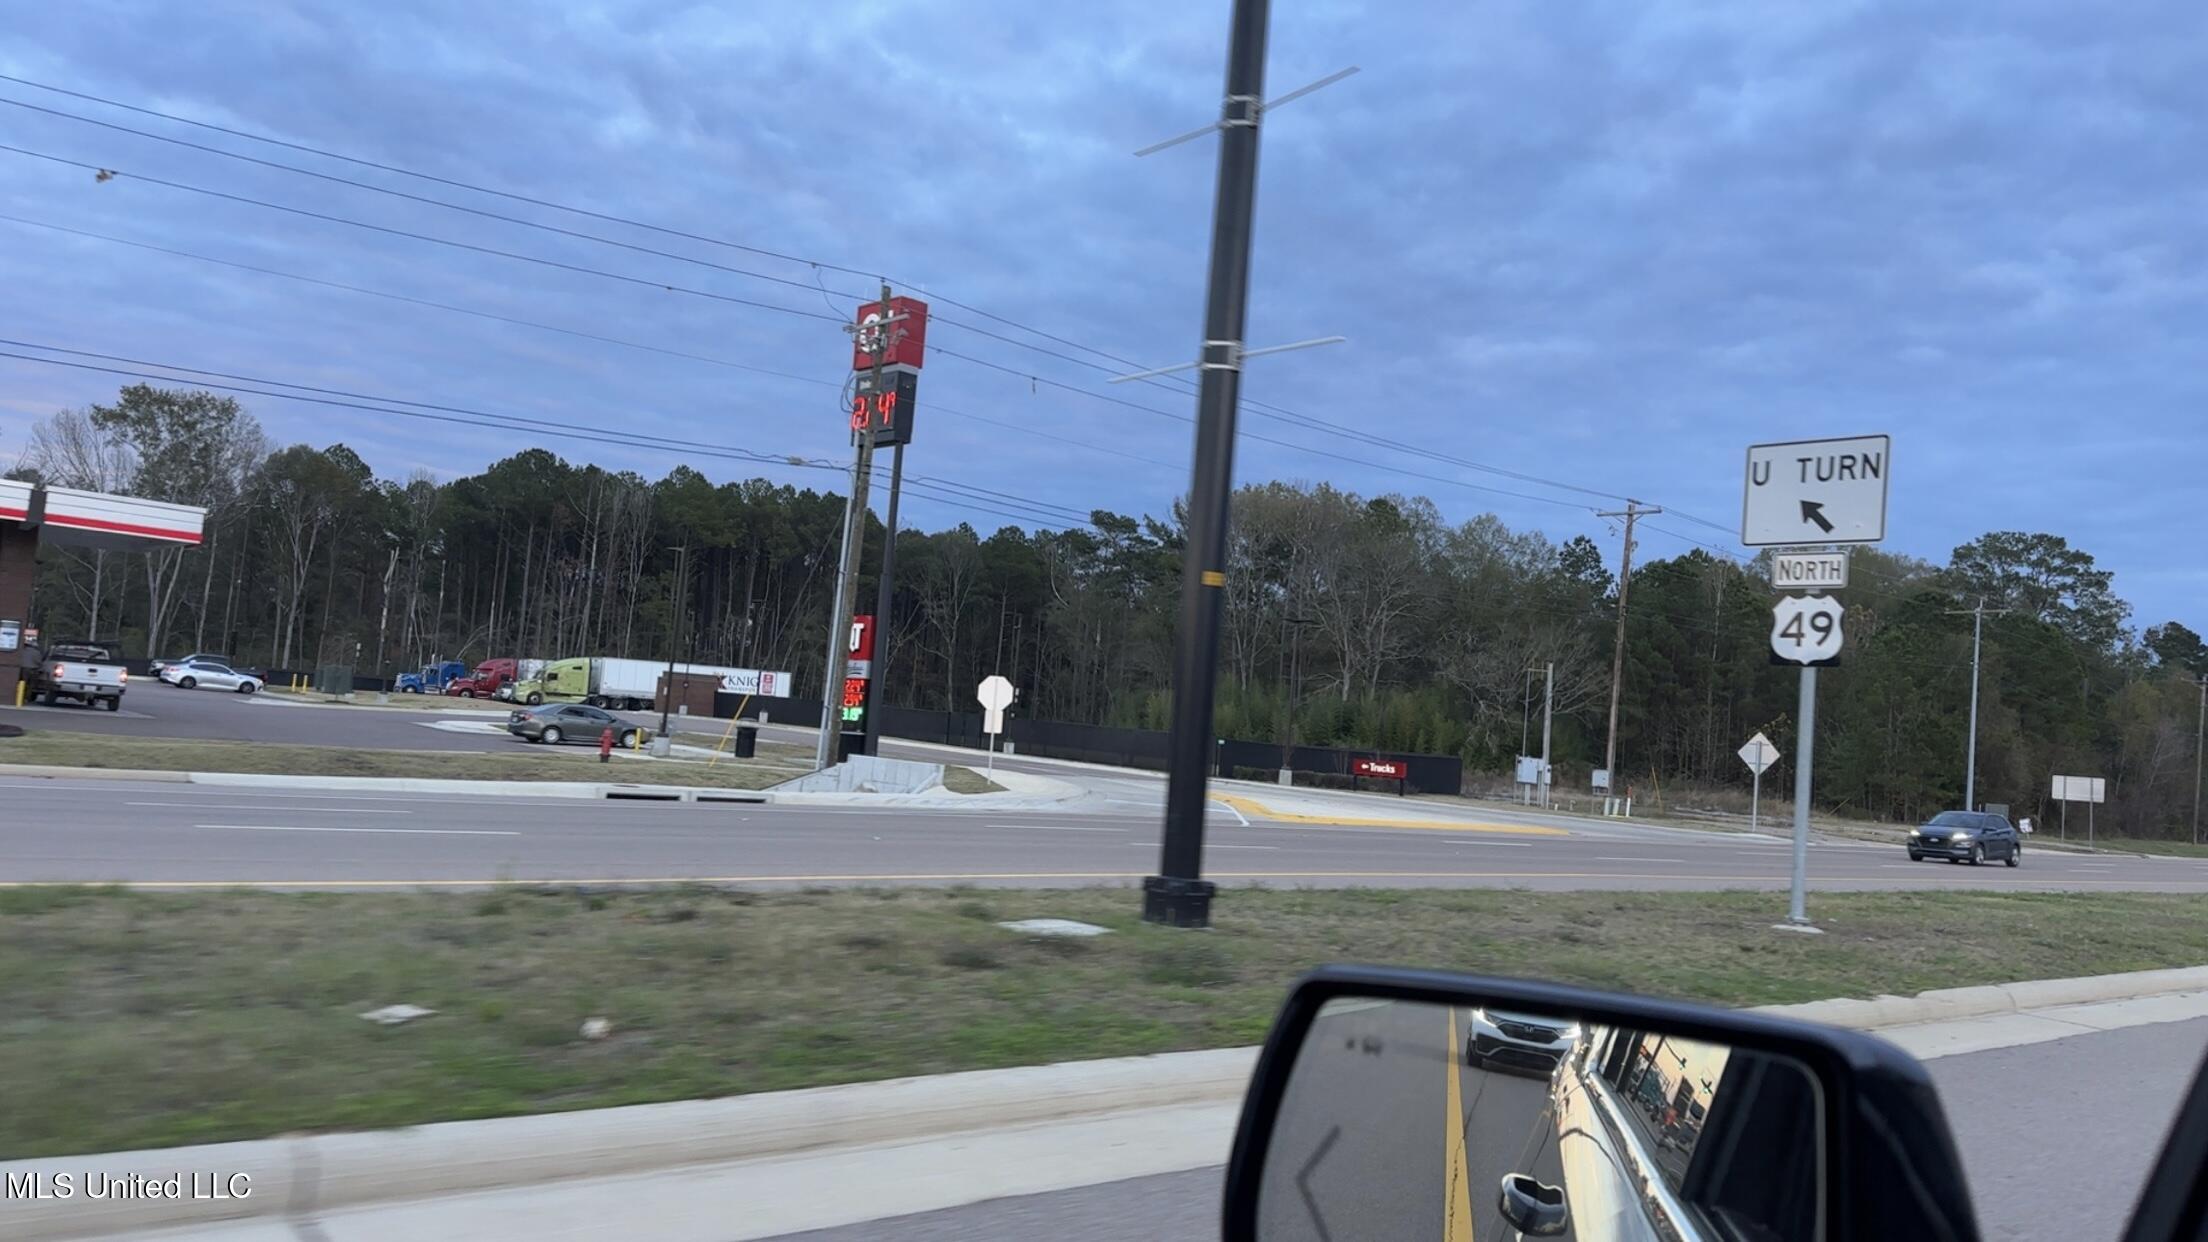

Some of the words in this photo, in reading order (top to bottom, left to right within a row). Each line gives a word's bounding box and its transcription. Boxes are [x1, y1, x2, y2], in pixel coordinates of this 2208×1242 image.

[1752, 460, 1771, 486] U
[1797, 452, 1881, 484] TURN
[1778, 559, 1842, 581] NORTH
[1779, 610, 1834, 647] 49
[1369, 761, 1396, 775] Trucks
